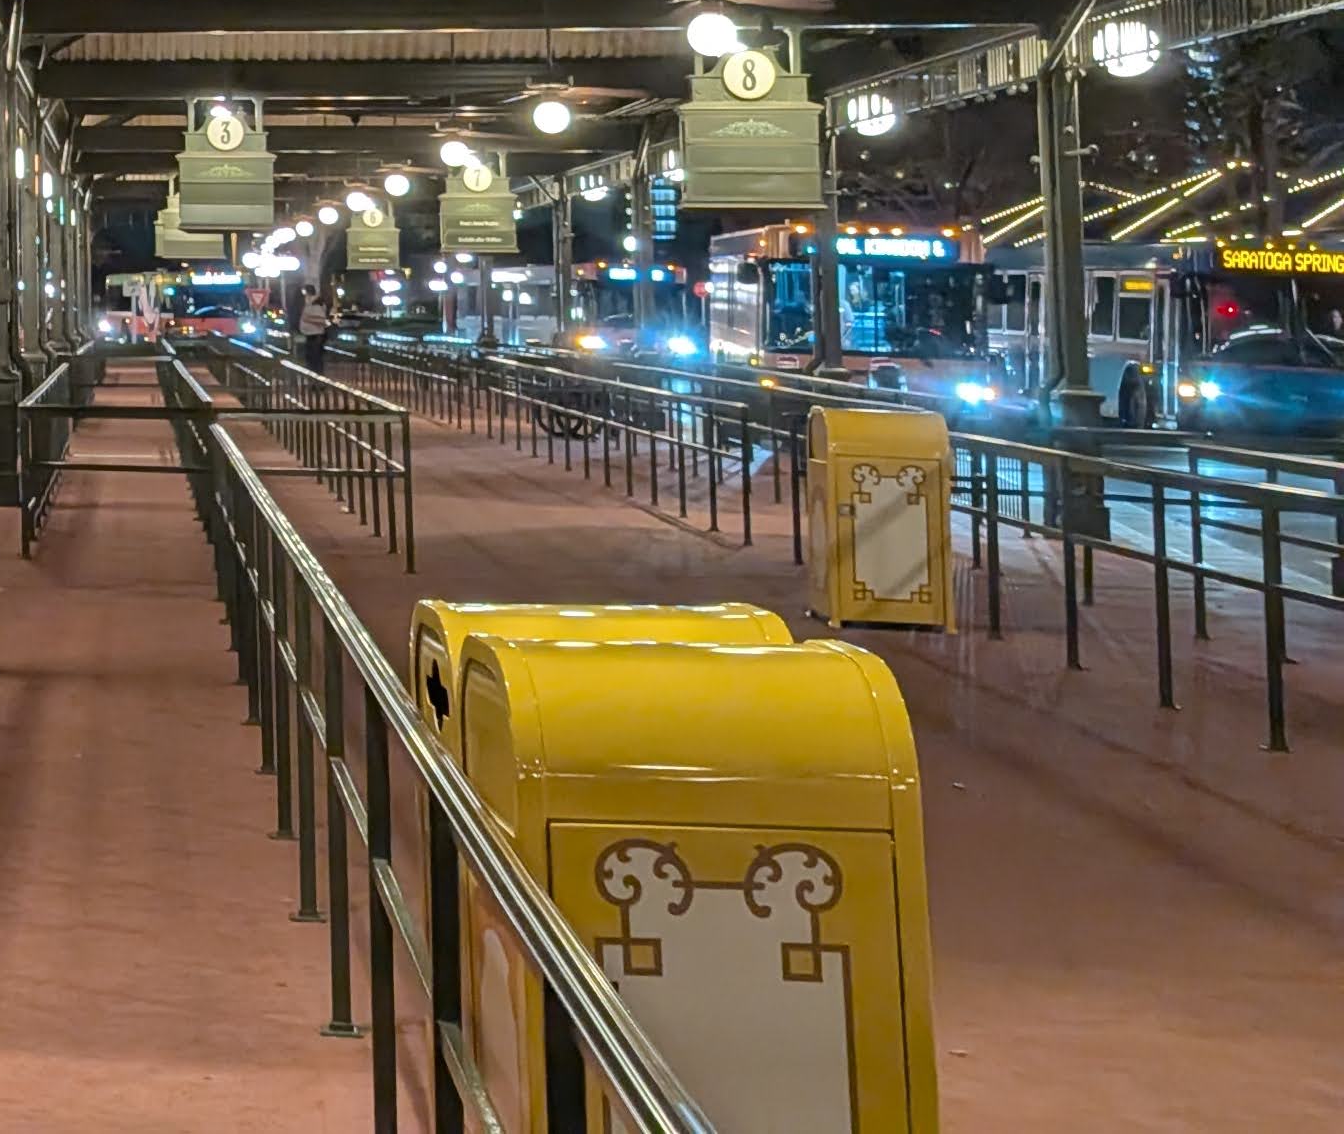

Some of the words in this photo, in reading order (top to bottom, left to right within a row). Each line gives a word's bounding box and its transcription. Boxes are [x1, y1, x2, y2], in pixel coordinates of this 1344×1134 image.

[742, 58, 757, 92] 8
[220, 121, 231, 145] 3
[474, 169, 481, 187] 7
[1223, 249, 1292, 271] SARATOGA
